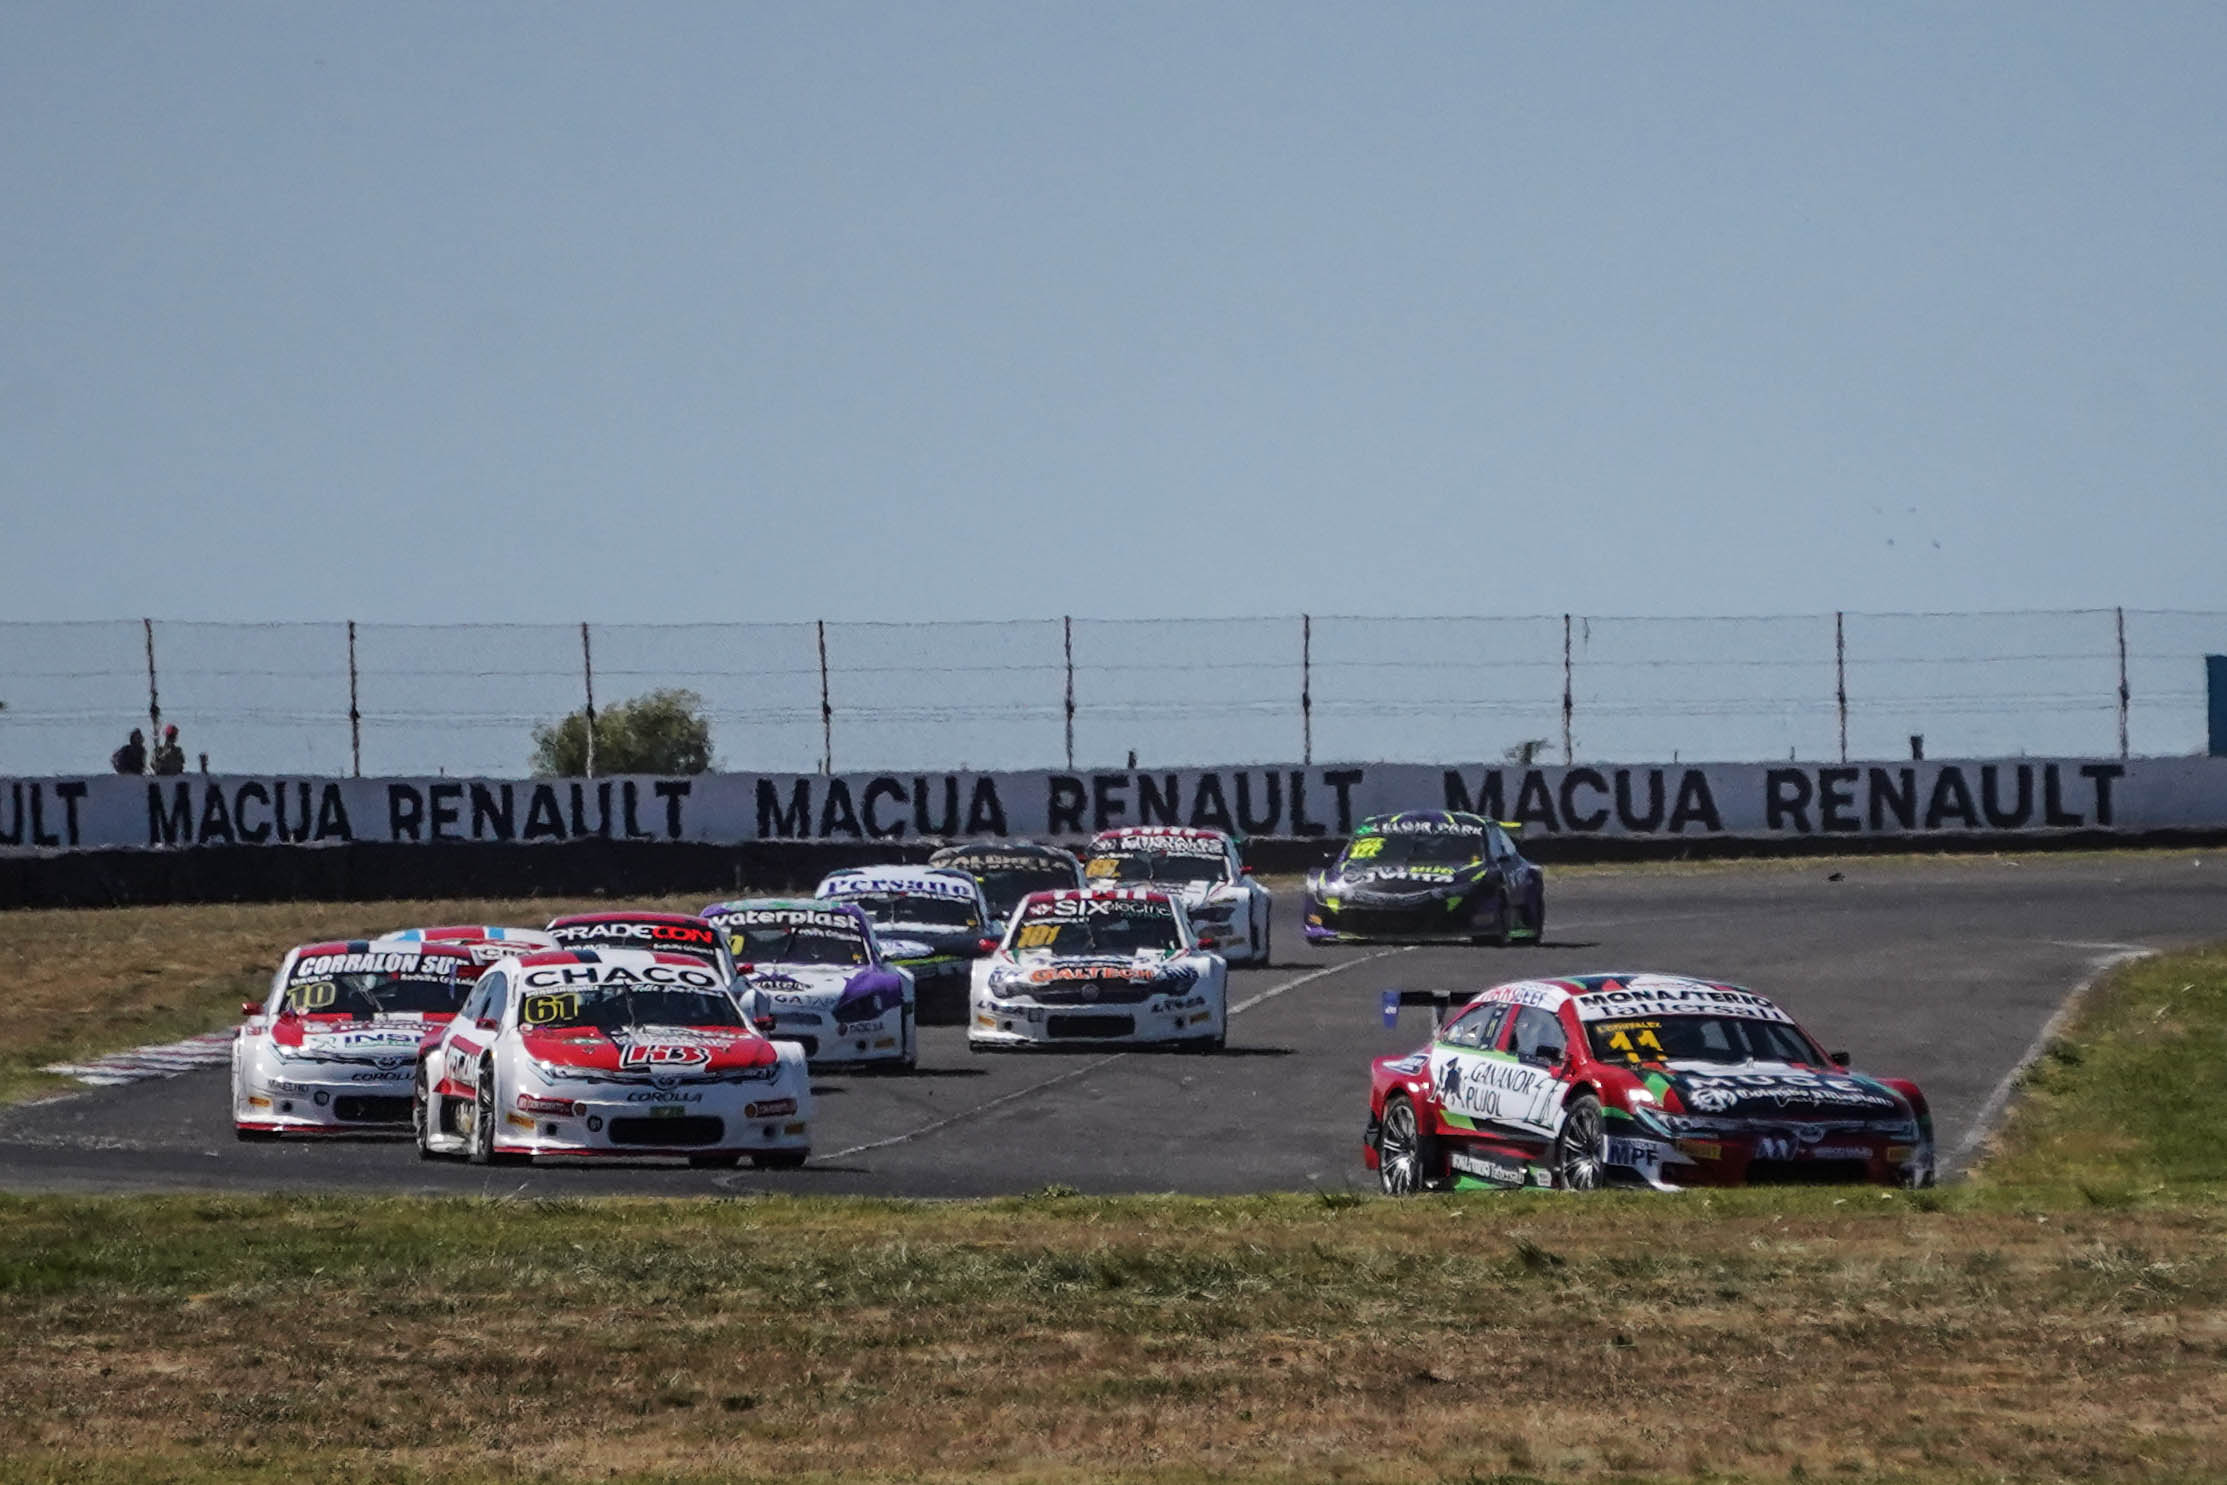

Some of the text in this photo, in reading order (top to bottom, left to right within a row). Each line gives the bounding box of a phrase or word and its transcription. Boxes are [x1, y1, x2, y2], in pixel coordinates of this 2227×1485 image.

[146, 779, 692, 845] MACUA RENAULT
[756, 769, 1363, 839] MACUA RENAULT
[1444, 764, 2125, 832] MACUA RENAULT
[524, 966, 717, 988] CHACO
[524, 992, 579, 1025] 61
[1581, 989, 1777, 1009] MONASTERIO
[1609, 1029, 1669, 1063] 11
[627, 1092, 703, 1102] COROLLA
[1466, 1086, 1503, 1117] PUJOL
[1610, 1145, 1659, 1166] MPF
